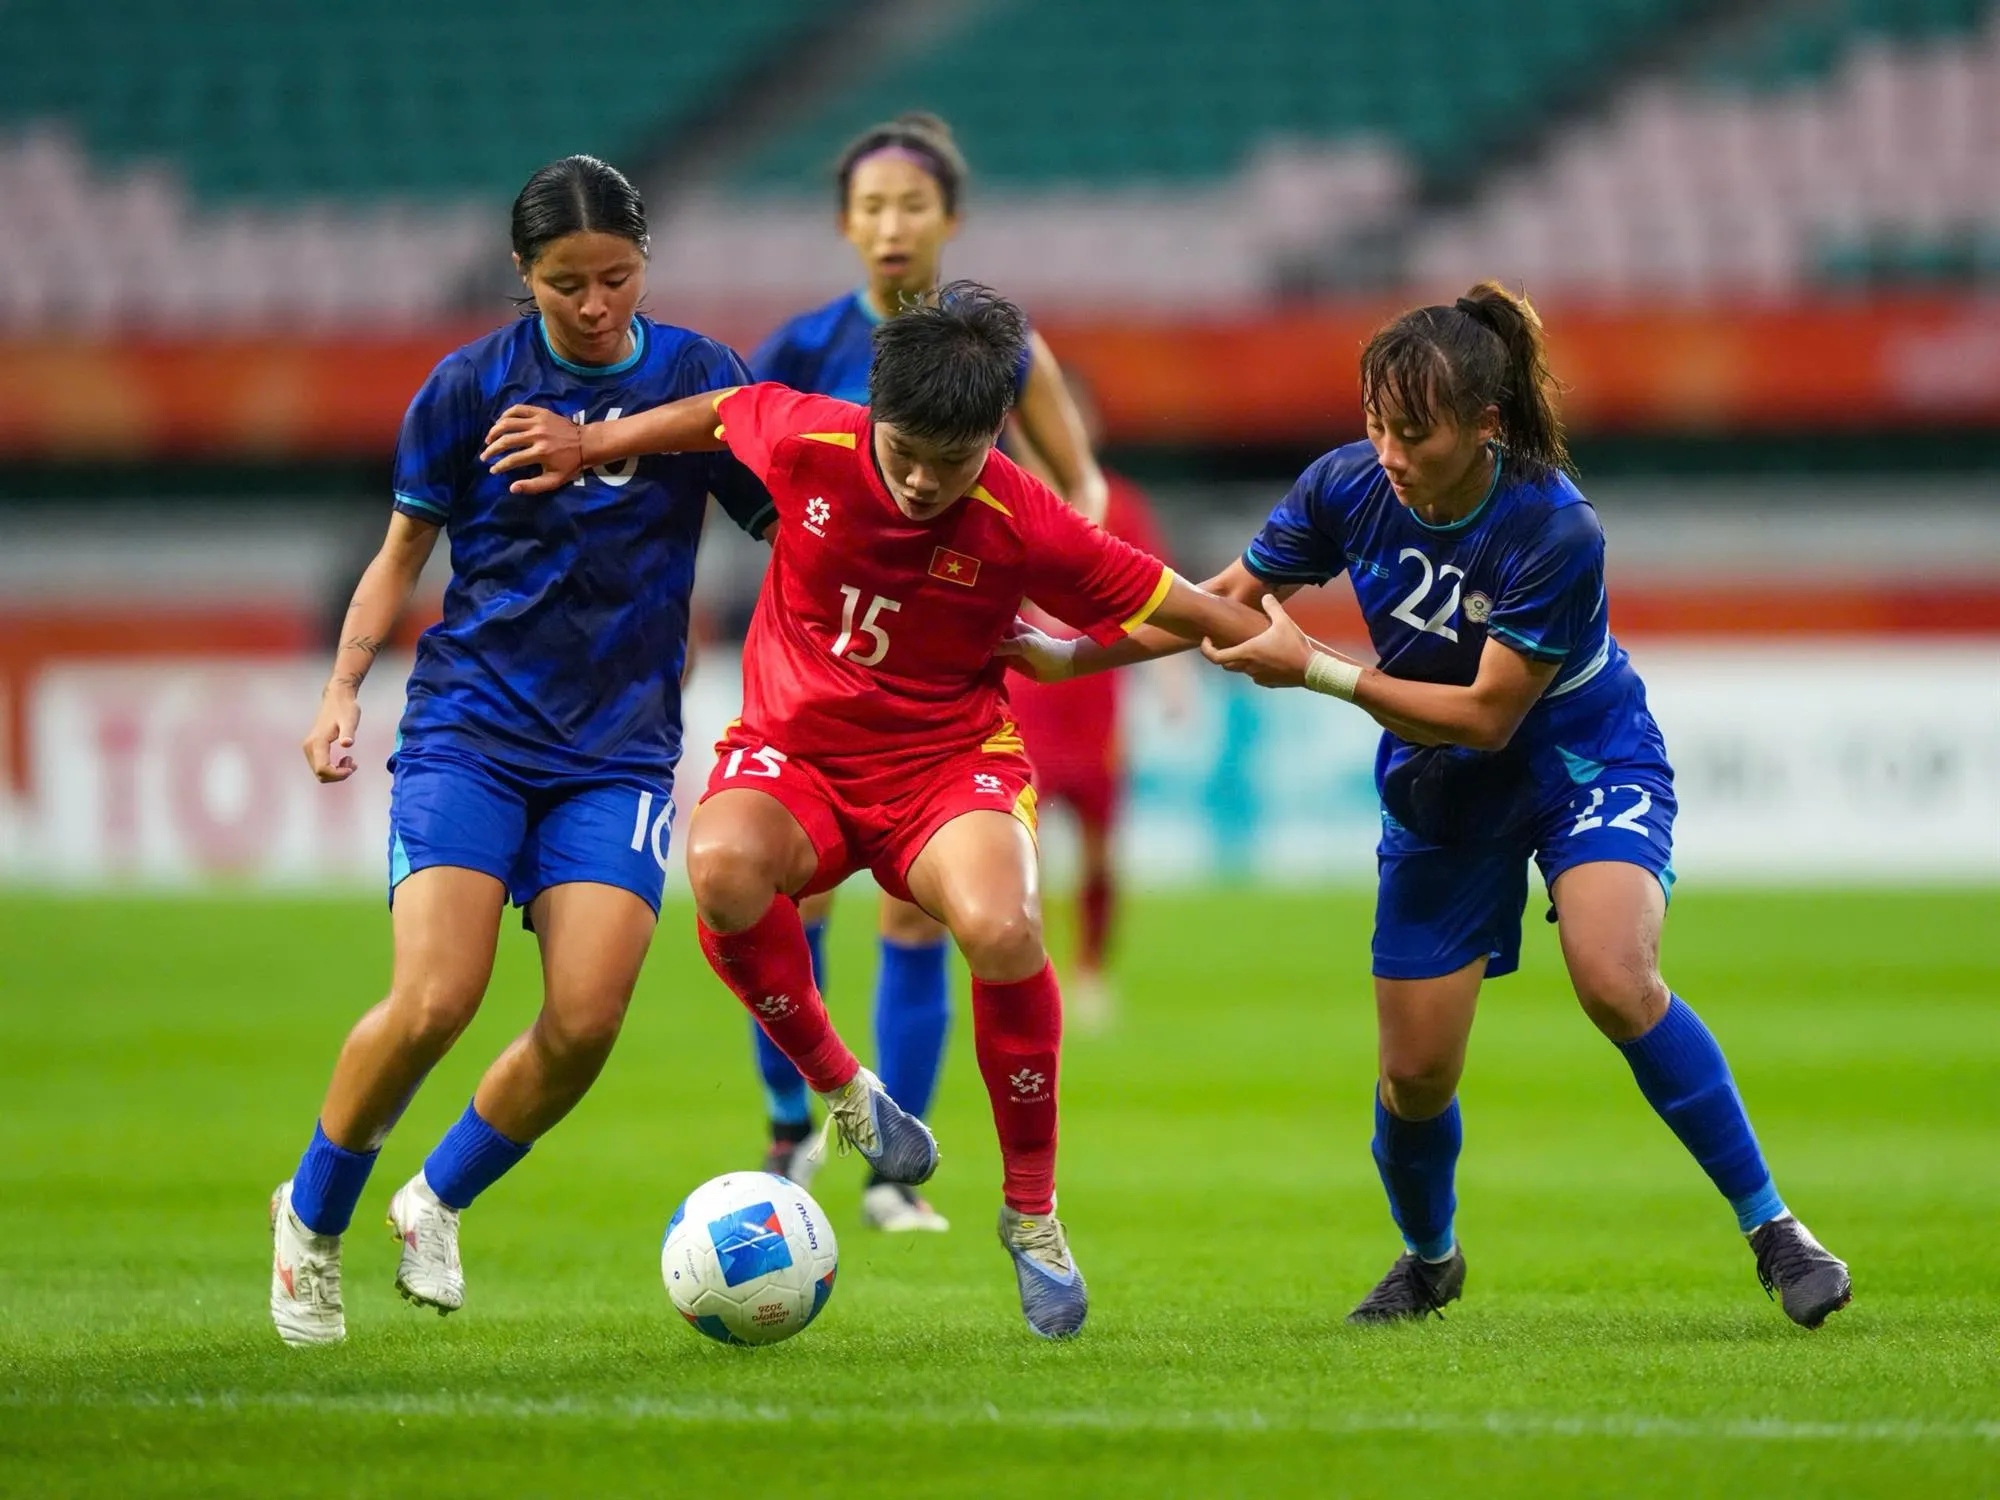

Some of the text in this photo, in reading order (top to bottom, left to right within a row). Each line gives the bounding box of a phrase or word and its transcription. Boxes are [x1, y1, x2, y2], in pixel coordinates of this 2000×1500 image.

[1390, 548, 1465, 643] 22
[831, 583, 902, 667] 15
[723, 745, 788, 780] 15
[1568, 784, 1652, 838] 22
[795, 1202, 819, 1251] molten
[758, 1302, 783, 1313] 2026
